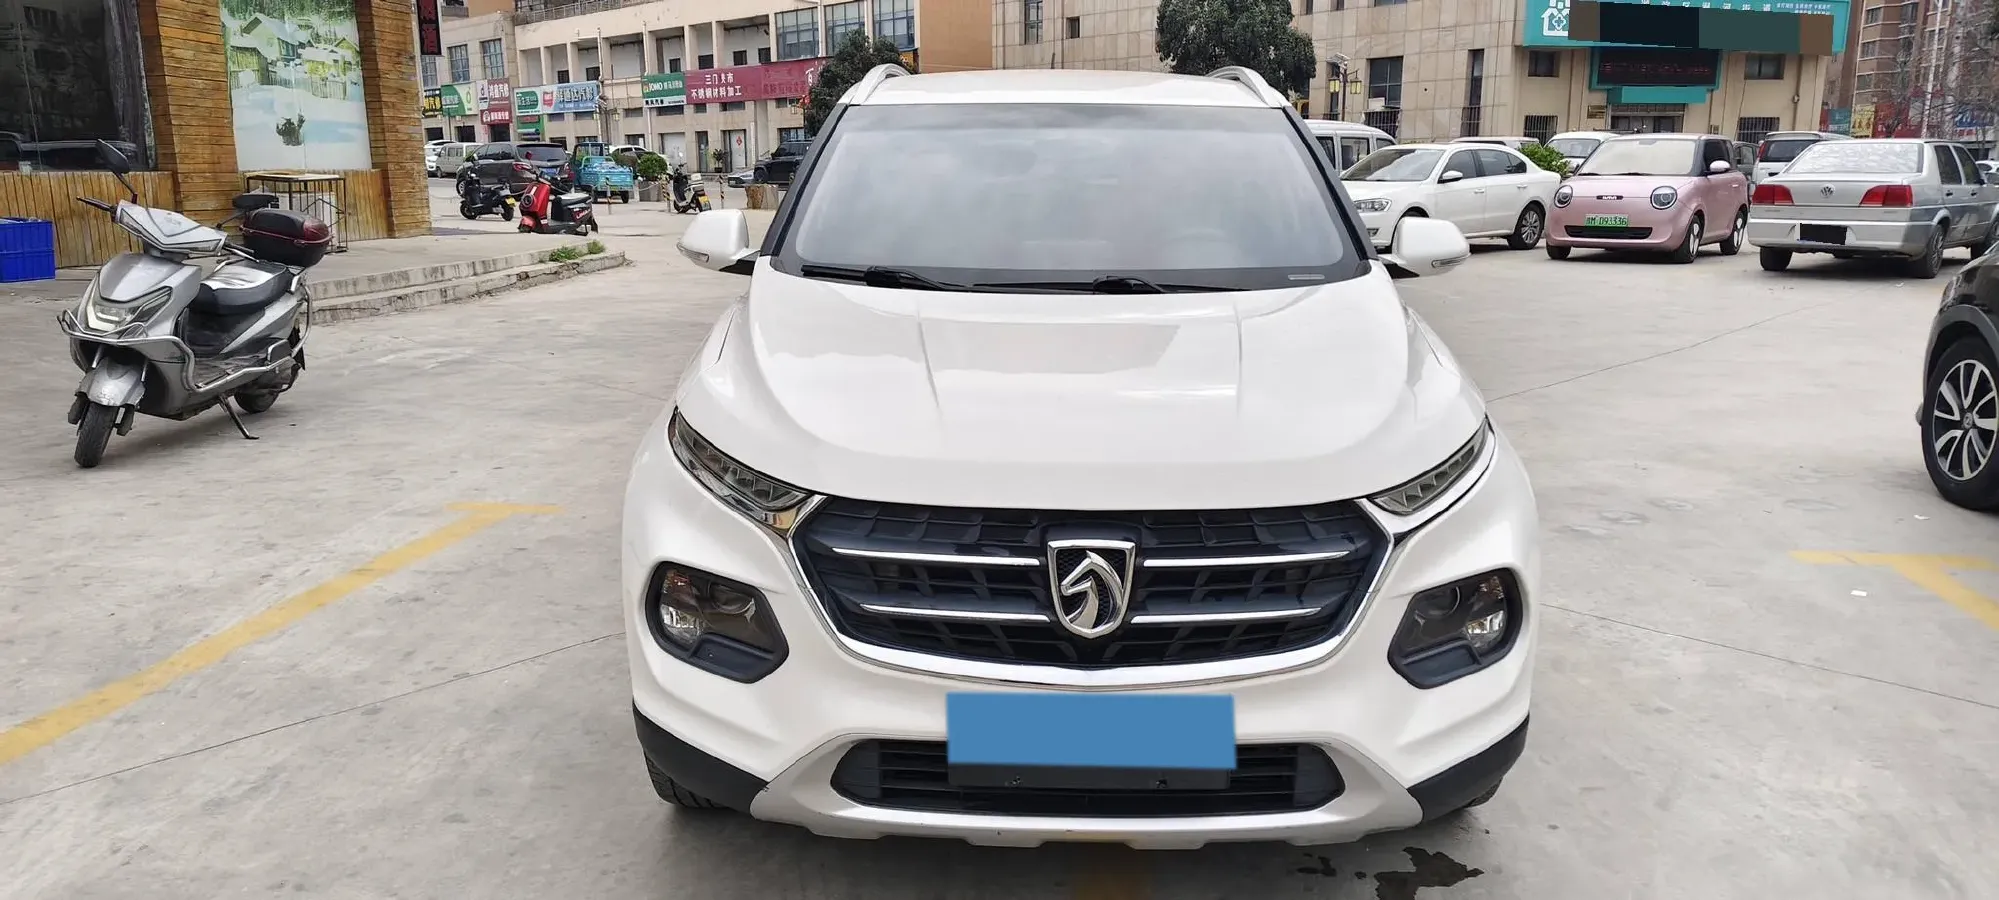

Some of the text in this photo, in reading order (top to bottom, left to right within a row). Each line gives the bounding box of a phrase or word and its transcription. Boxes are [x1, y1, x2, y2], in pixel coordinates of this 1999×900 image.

[690, 85, 743, 100] 不锈钢材料加工
